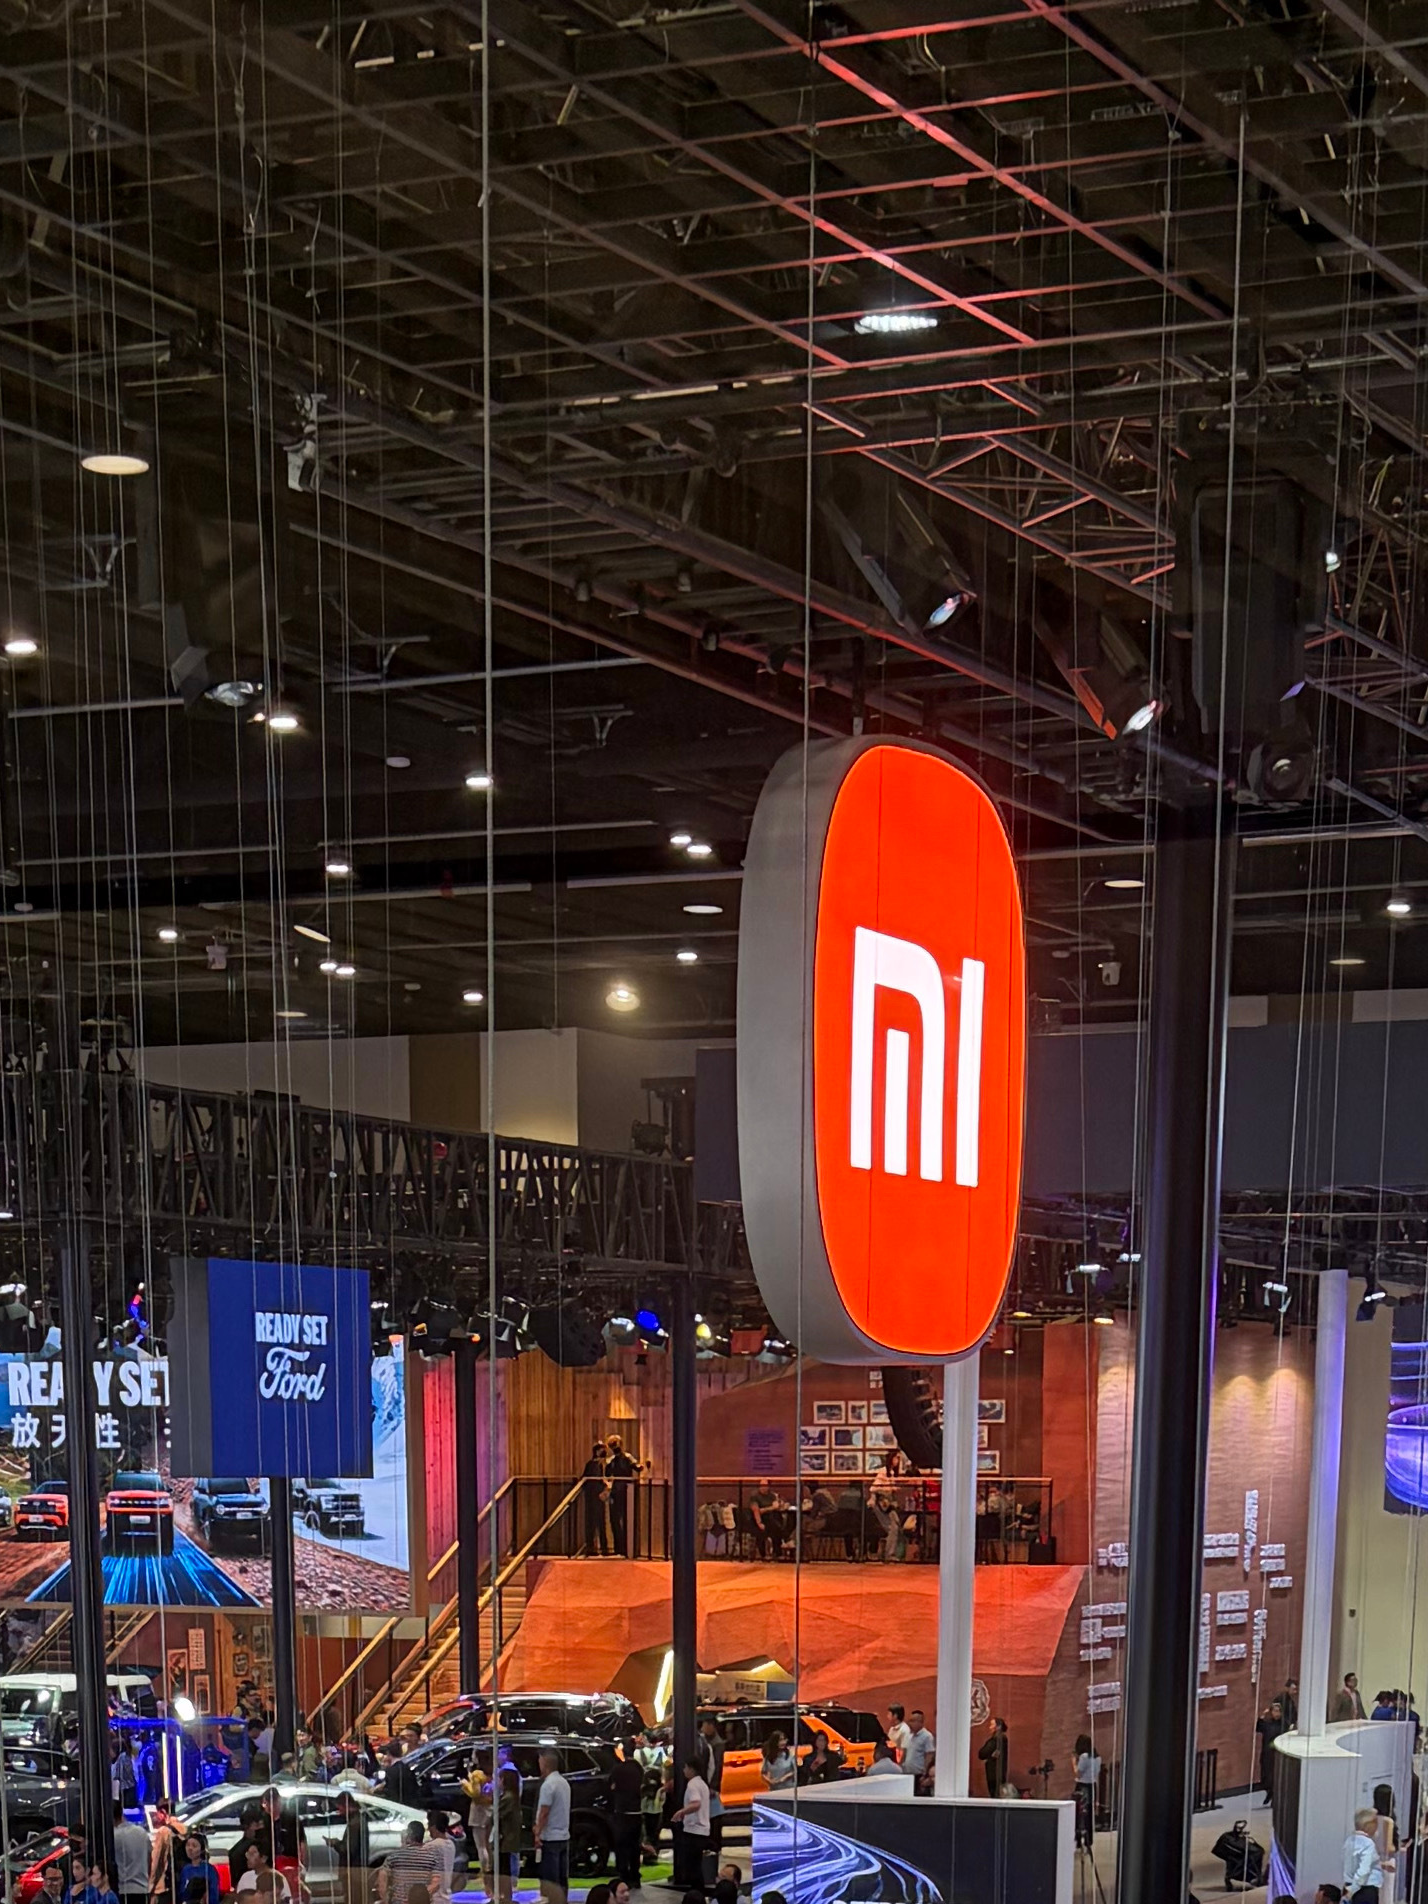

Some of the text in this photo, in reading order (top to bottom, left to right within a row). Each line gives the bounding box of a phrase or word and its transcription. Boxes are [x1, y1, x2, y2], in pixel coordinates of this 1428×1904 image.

[255, 1312, 328, 1346] READY SET
[8, 1361, 114, 1406] REAY
[259, 1346, 326, 1401] Ford
